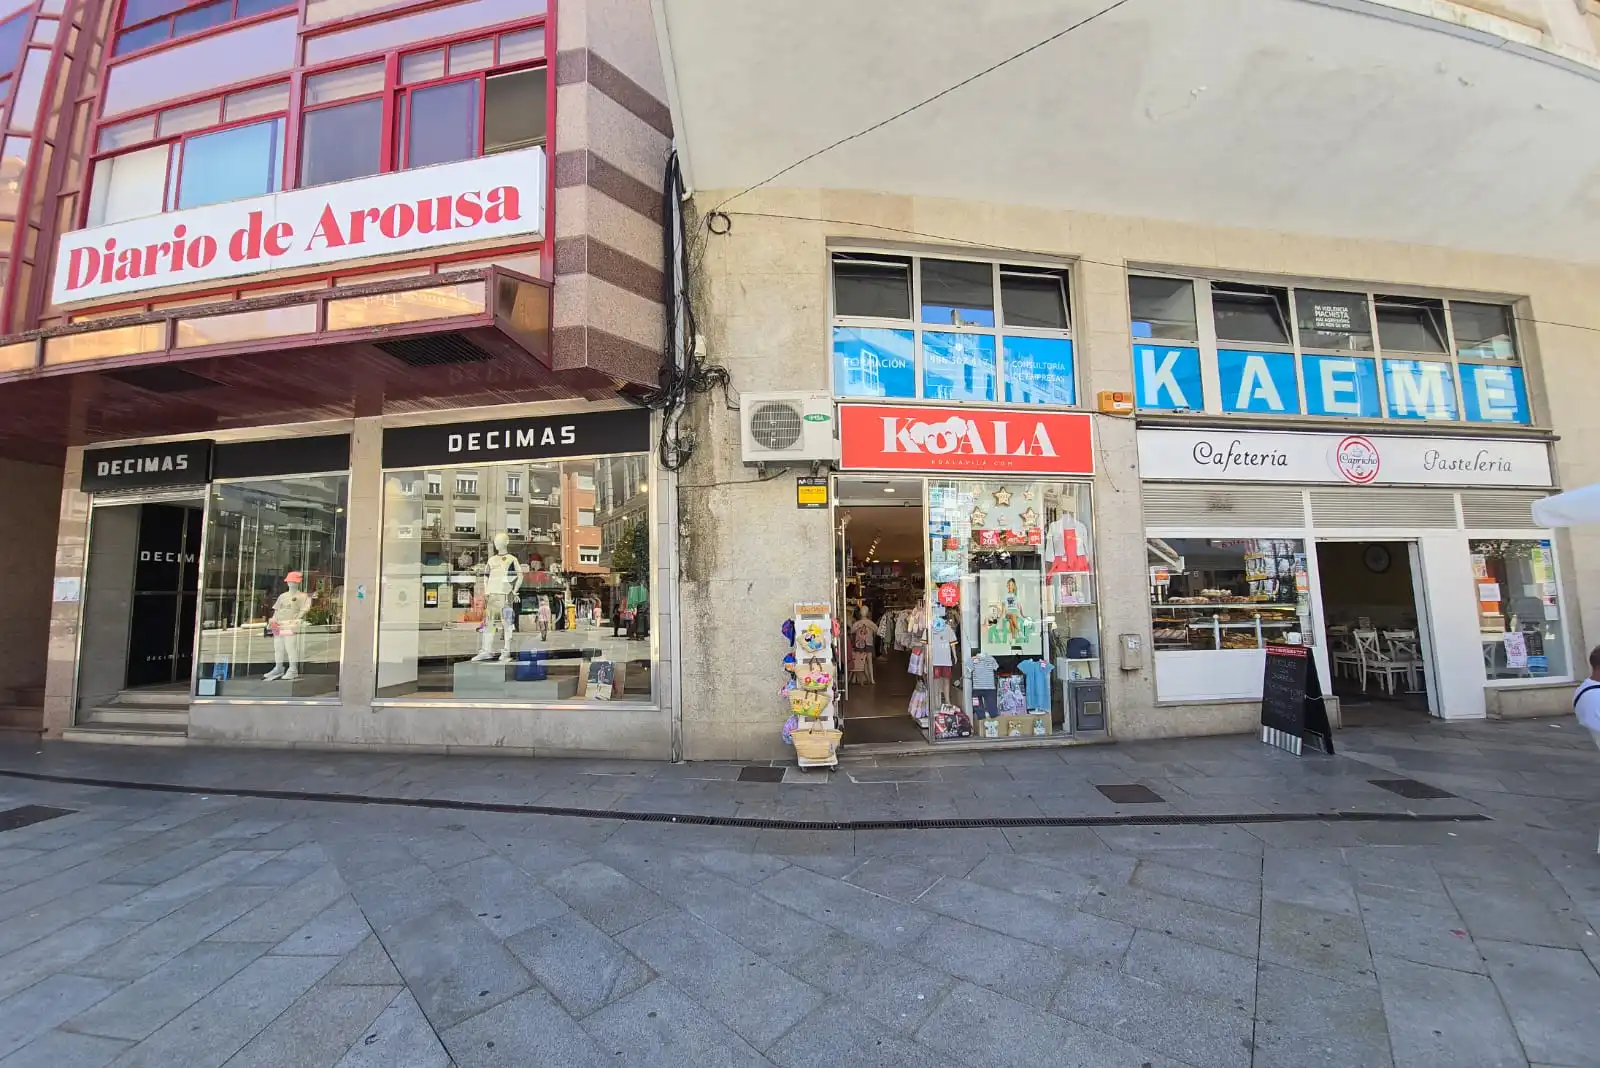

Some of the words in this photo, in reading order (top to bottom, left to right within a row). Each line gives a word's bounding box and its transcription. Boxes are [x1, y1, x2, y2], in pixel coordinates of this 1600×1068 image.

[65, 223, 217, 292] Diario
[228, 210, 294, 261] de
[304, 183, 522, 252] Arousa
[1140, 349, 1521, 422] KAEME
[448, 425, 576, 453] DECIMAS
[879, 415, 1061, 457] KOALA
[97, 454, 188, 477] DECIMAS
[1339, 452, 1378, 469] Capricho
